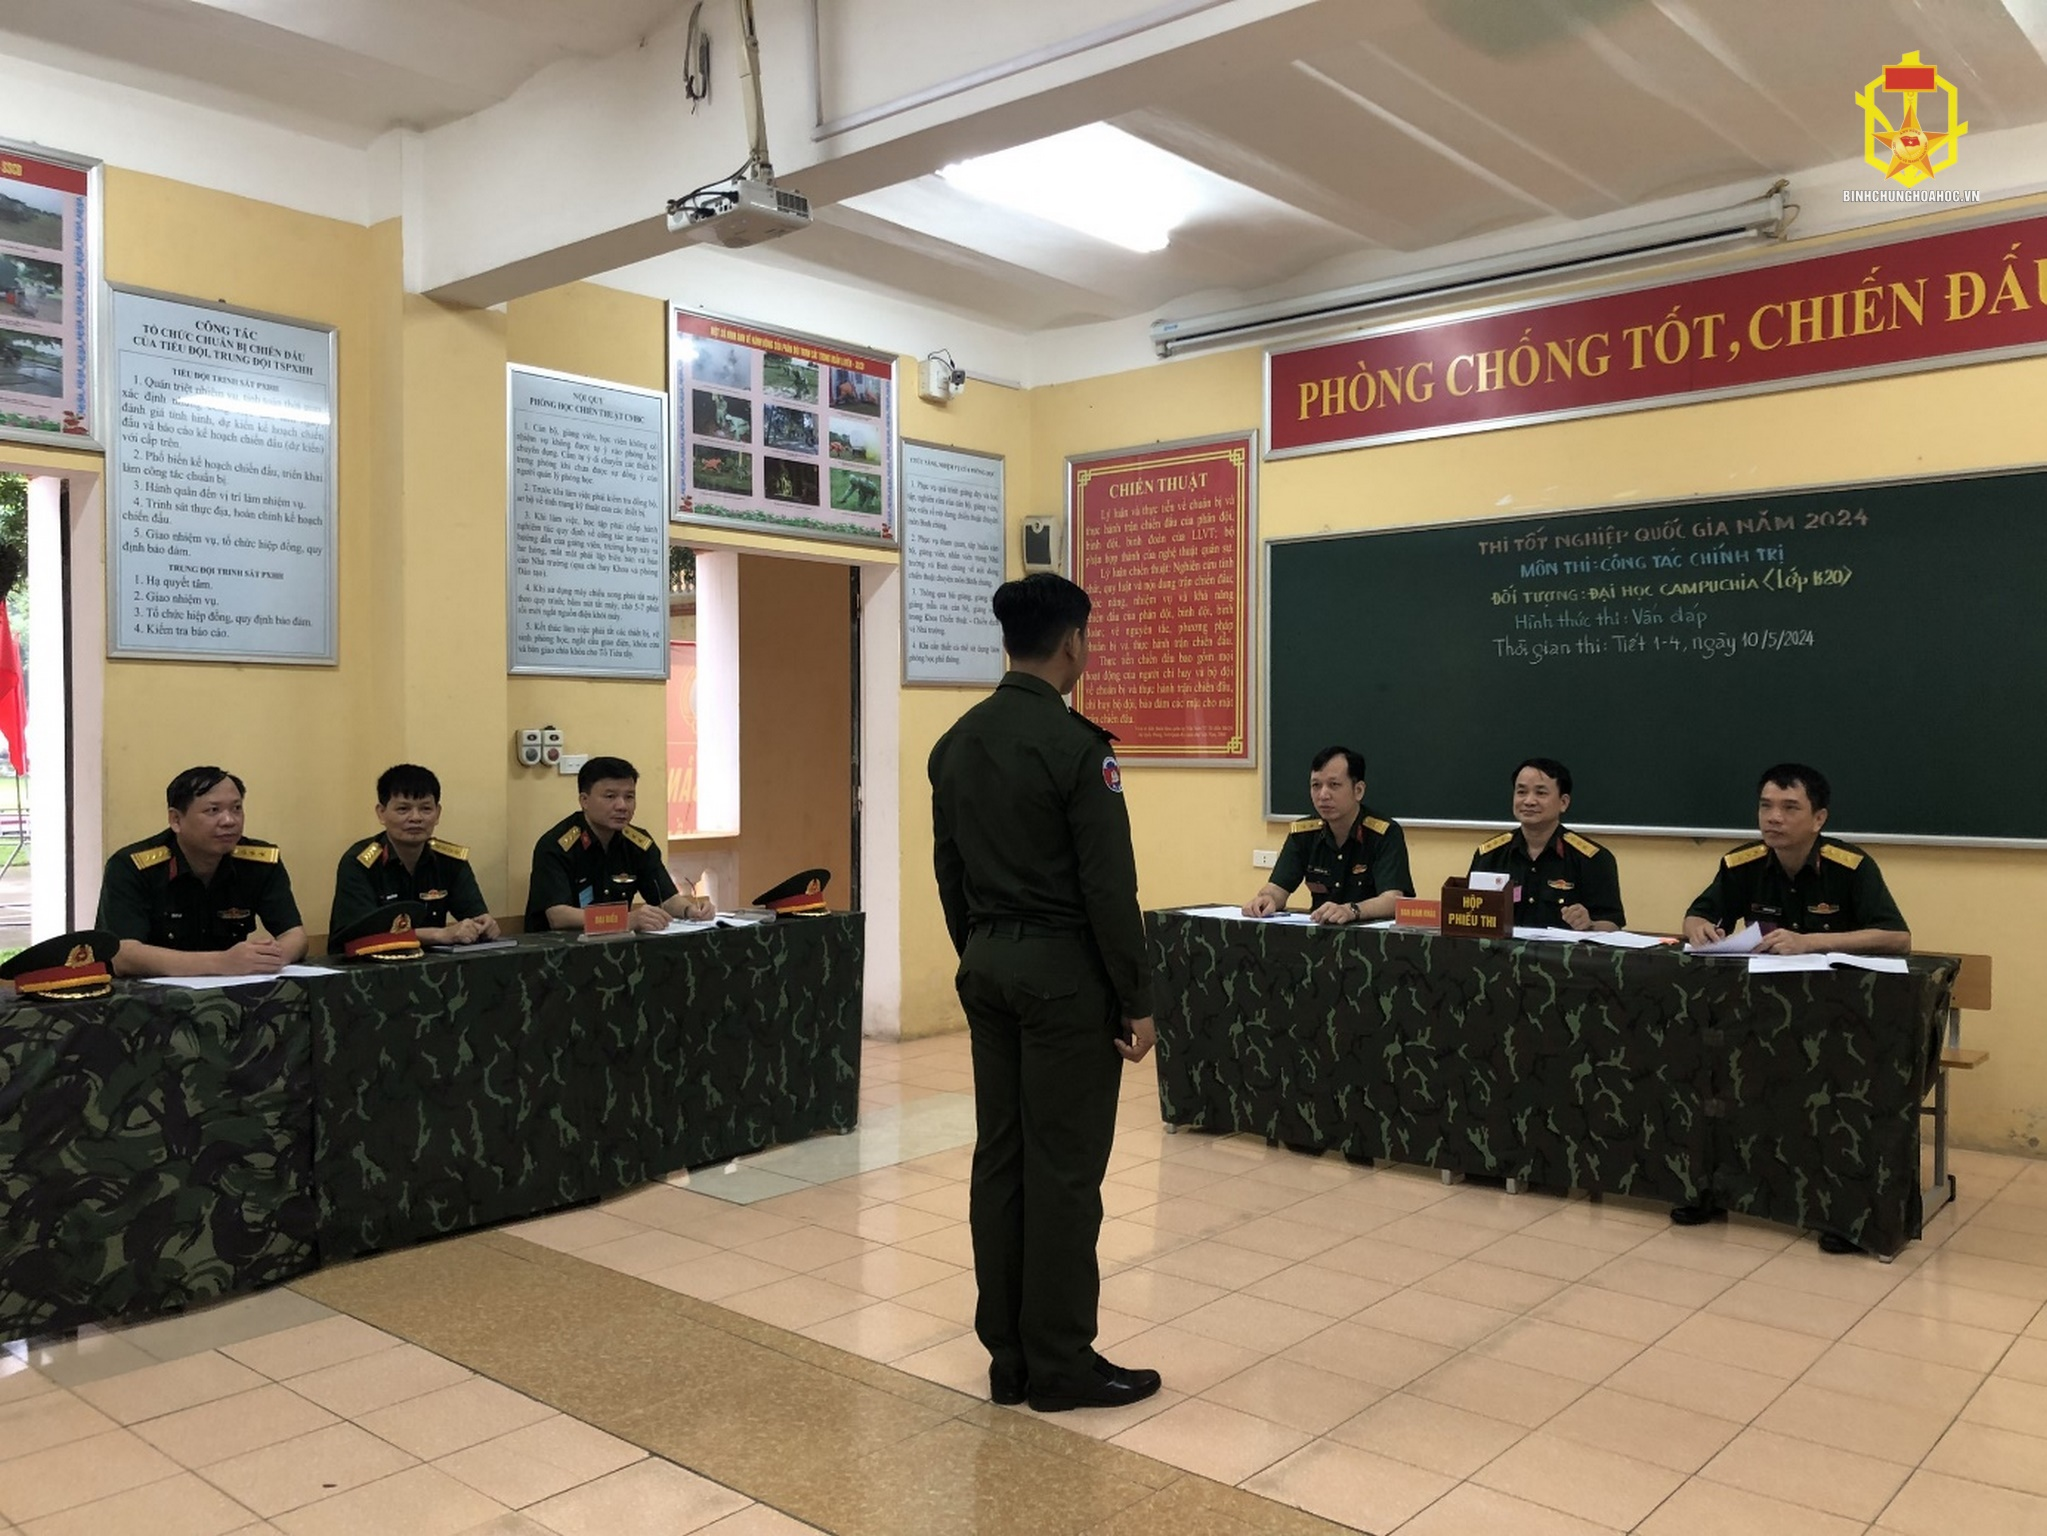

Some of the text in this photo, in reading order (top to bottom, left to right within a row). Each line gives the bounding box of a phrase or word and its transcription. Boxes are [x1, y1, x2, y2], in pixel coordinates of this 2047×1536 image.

[142, 324, 305, 362] TỔ CHỨC CHUẨN BỊ CHIẾN ĐẤU
[195, 320, 258, 340] CÔNG TÁC
[1298, 359, 1434, 421] PHÒNG
[1446, 328, 1611, 398] CHỐNG
[1623, 304, 1739, 371] TỐT,
[1749, 266, 1927, 350] CHIẾN
[132, 336, 313, 375] CỦA TIỂU ĐỘI, TRUNG ĐỘI TSPXHH
[1109, 472, 1207, 498] CHIẾN THUẬT
[1479, 508, 1869, 555] THI TỐT NGHIỆP QUỐC GIA NĂM 2024
[1520, 559, 1558, 578] MÔN
[1652, 548, 1682, 569] TÁC
[1690, 543, 1749, 567] CHÍNH
[1756, 544, 1784, 565] TRỊ
[1491, 585, 1517, 605] ĐỐI
[1622, 586, 1653, 601] HỌC
[1660, 573, 1760, 596] CAMPUCHIA
[1515, 612, 1553, 630] Hình
[1556, 609, 1592, 627] thức
[1632, 603, 1663, 625] Vấn
[1492, 629, 1814, 665] Thời gian thi: Tiết 1-4, ngày 10/5/2024
[1463, 894, 1483, 911] HỘP
[1448, 911, 1497, 928] PHIẾU THI
